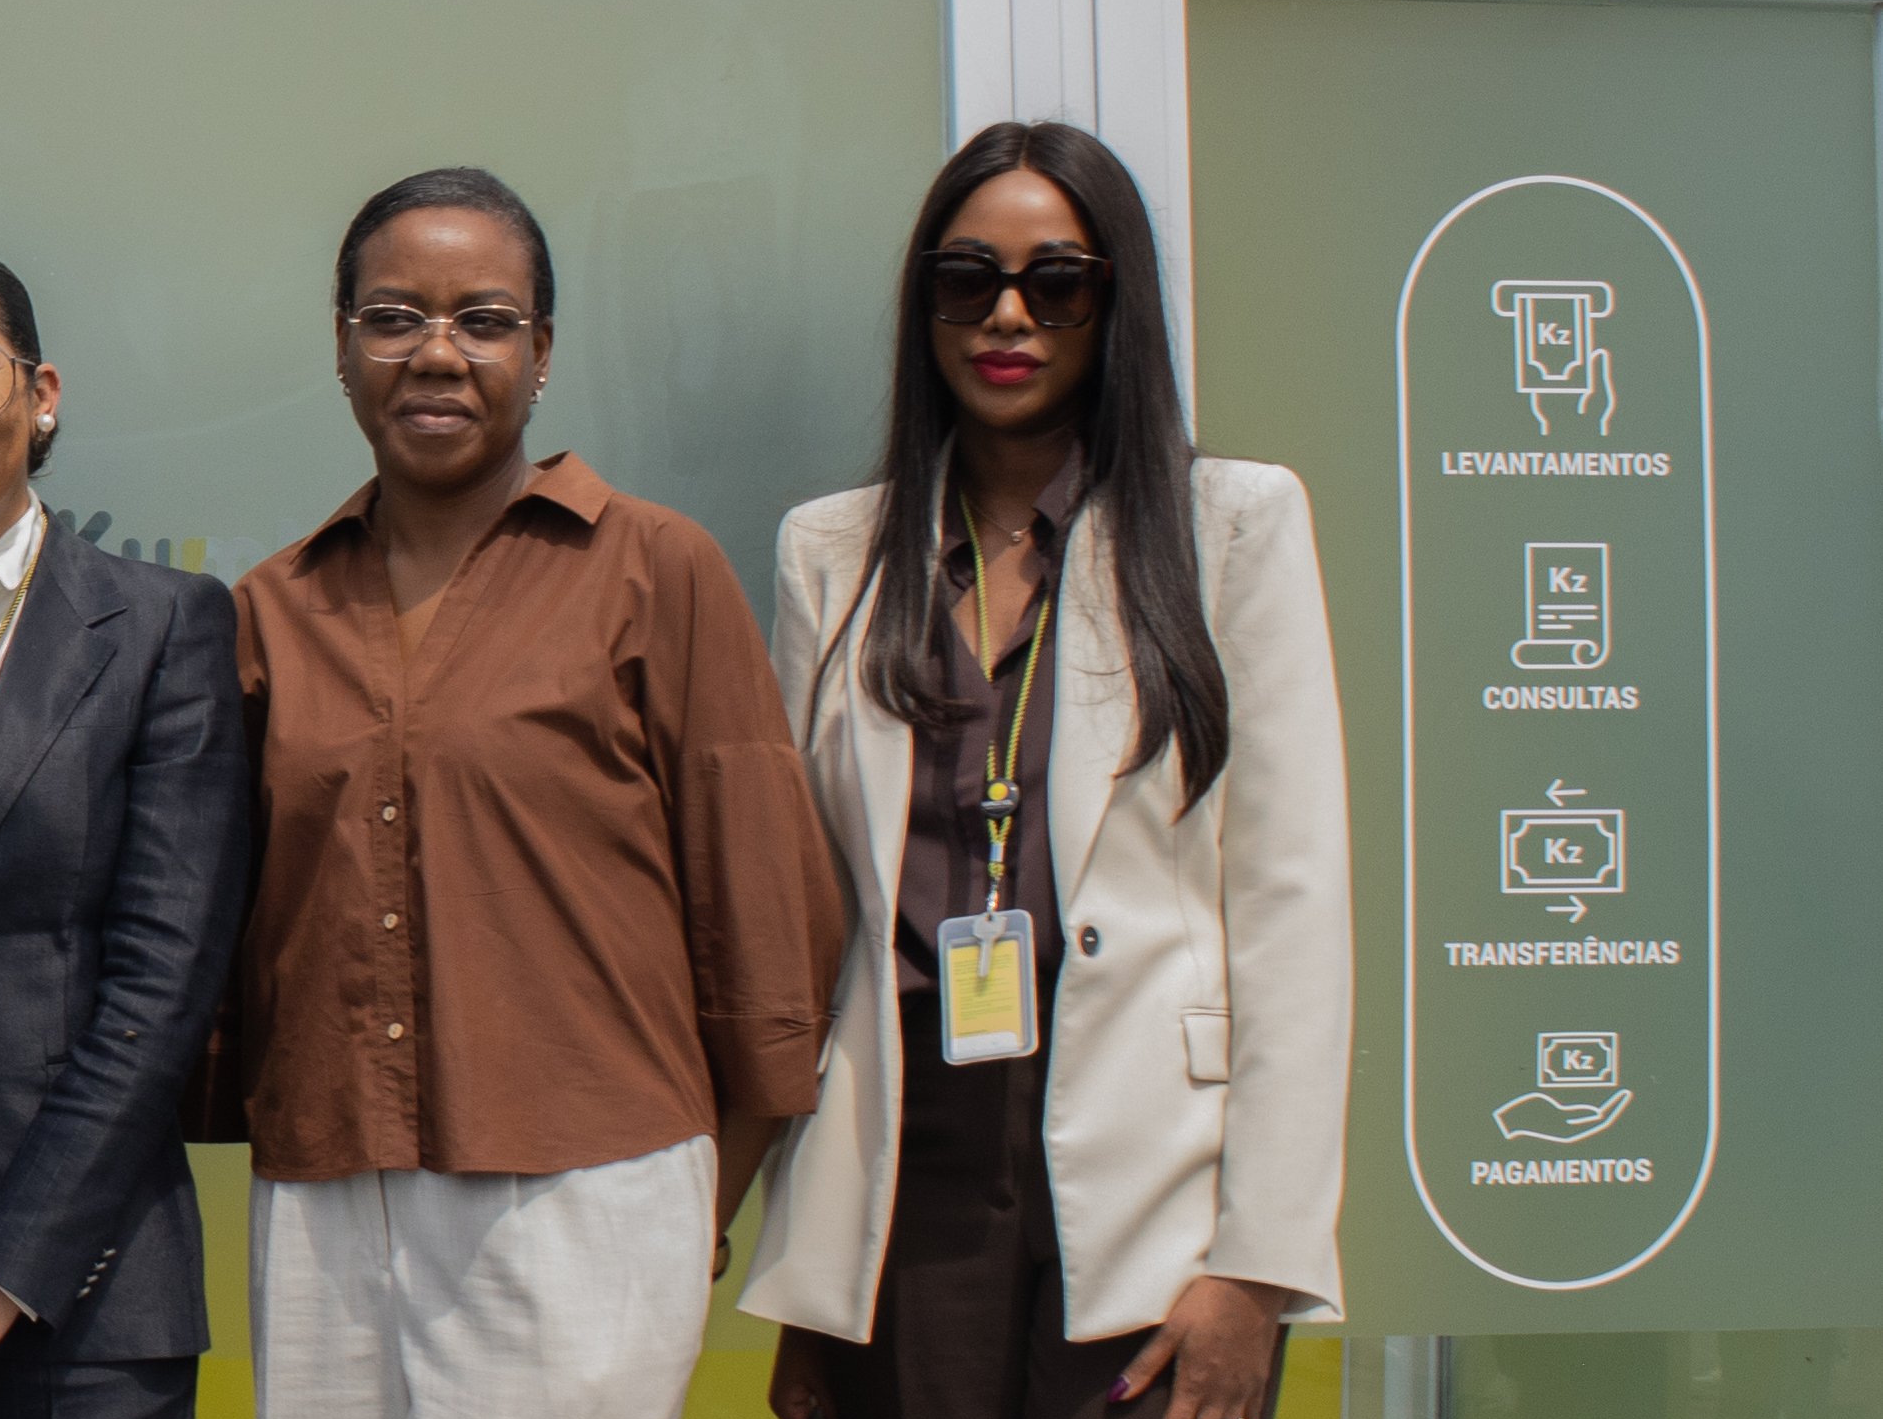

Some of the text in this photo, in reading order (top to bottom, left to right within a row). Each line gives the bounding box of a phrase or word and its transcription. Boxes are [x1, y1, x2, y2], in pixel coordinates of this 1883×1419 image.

[1537, 322, 1572, 346] Kz
[1441, 451, 1673, 477] LEVANTAMENTOS
[1547, 566, 1589, 594] Kz
[1482, 685, 1641, 710] CONSULTAS
[1544, 837, 1584, 864] Kz
[1443, 935, 1681, 967] TRANSFERÊNCIAS
[1562, 1049, 1595, 1071] Kz
[1470, 1157, 1654, 1185] PAGAMENTOS
